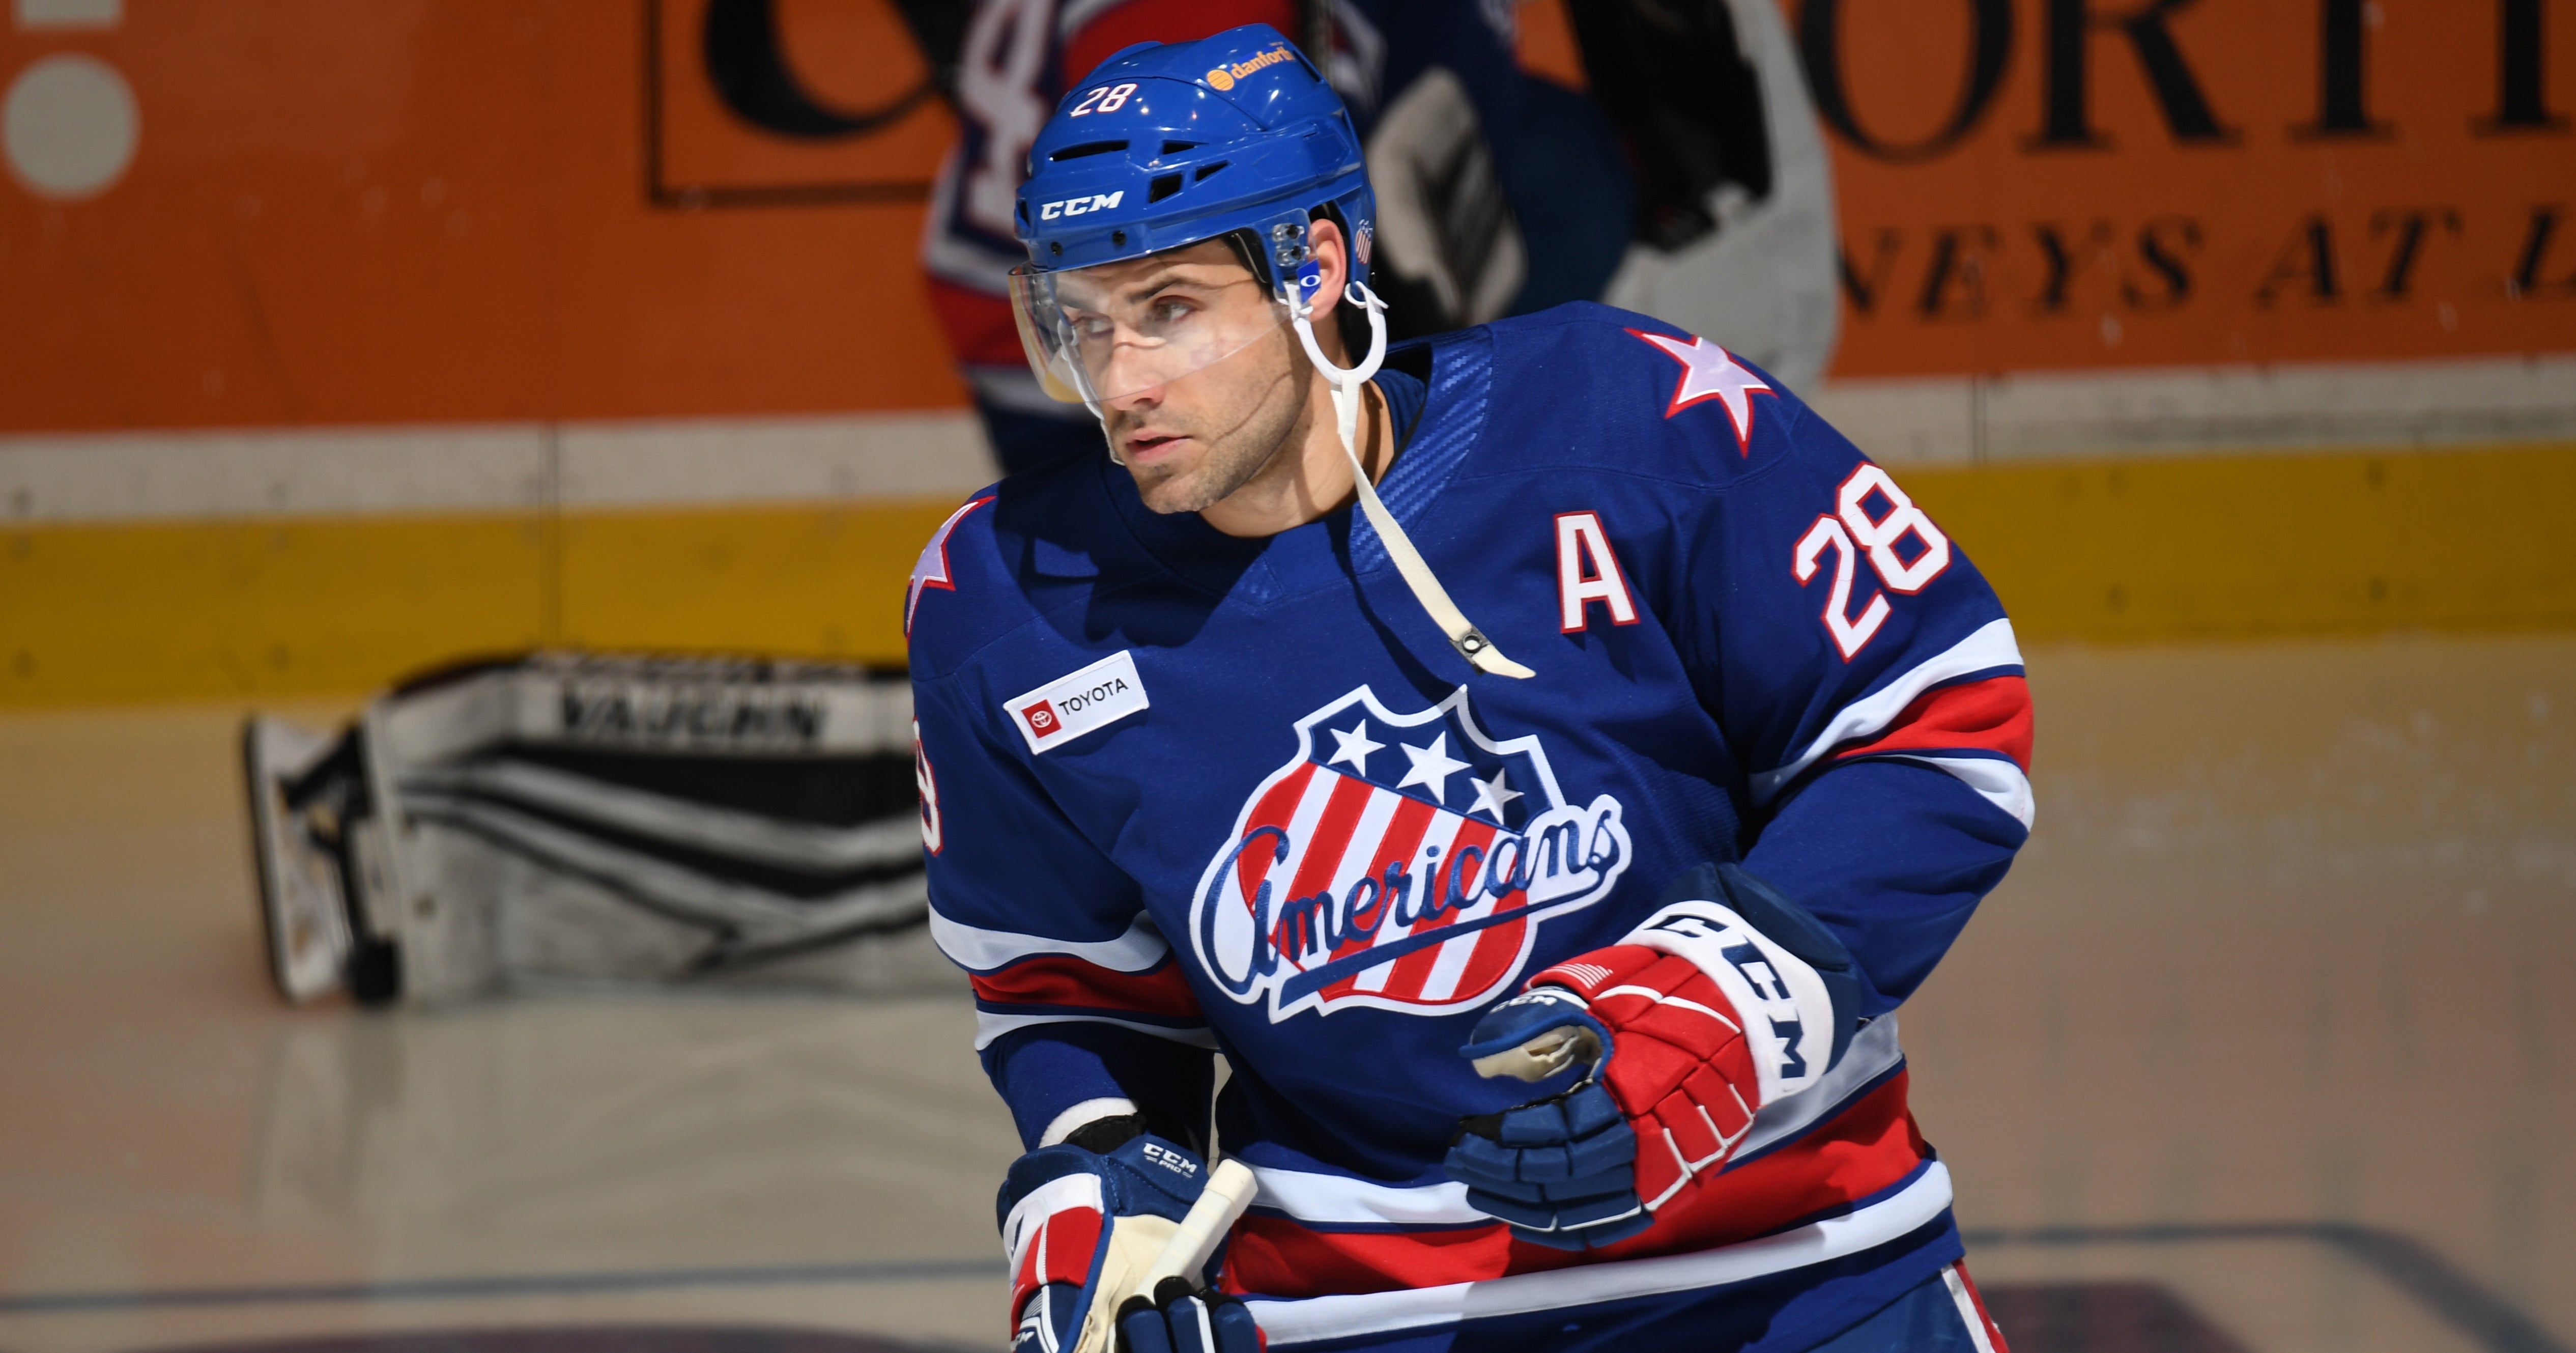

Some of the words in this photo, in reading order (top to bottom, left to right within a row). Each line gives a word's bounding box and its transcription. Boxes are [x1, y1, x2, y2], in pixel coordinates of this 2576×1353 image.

[1070, 83, 1139, 118] 28
[1041, 190, 1124, 220] CCM
[2252, 206, 2463, 311] AT
[1553, 510, 1641, 634] A
[1791, 461, 1951, 663] 28
[1058, 678, 1129, 715] TOYOTA
[1200, 808, 1620, 1008] Americans
[1644, 914, 1806, 1079] CCM
[1143, 1142, 1197, 1173] CCM
[1159, 1160, 1182, 1173] PRO
